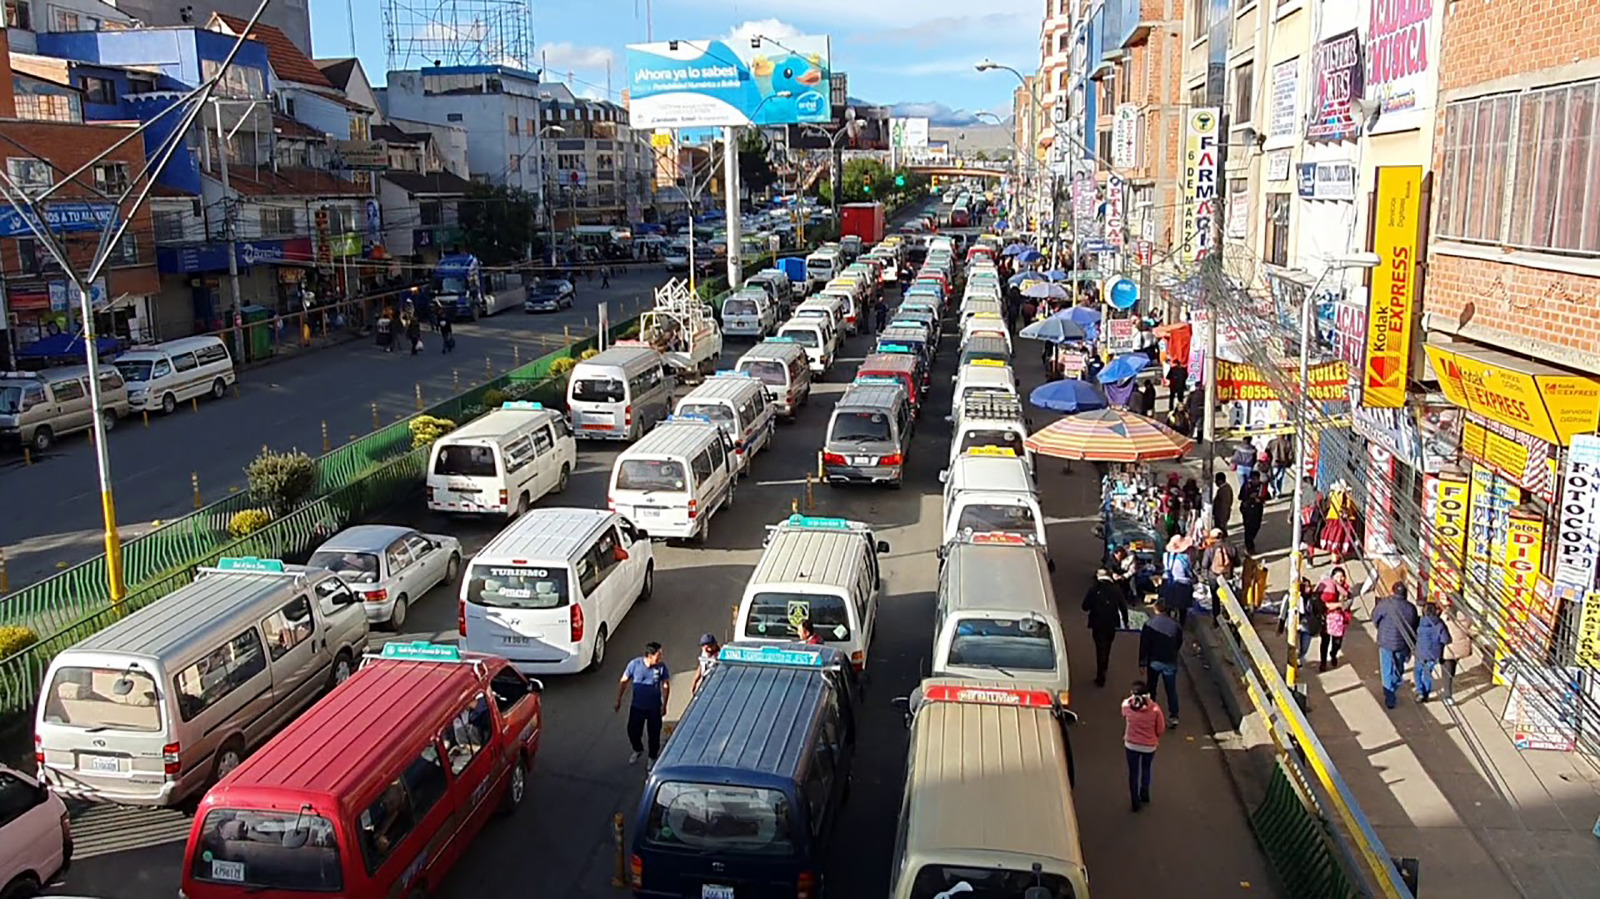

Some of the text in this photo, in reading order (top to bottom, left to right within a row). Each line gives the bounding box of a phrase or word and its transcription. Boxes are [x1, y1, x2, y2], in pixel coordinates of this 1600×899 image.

[635, 66, 738, 83] ¡Ahora ya lo sabes!
[1187, 167, 1194, 189] DE
[1389, 246, 1408, 333] EXPRESS
[1374, 306, 1389, 351] Kodak
[1475, 387, 1530, 421] EXPRESS
[1437, 487, 1462, 537] FOTO
[490, 567, 549, 578] TURISMO
